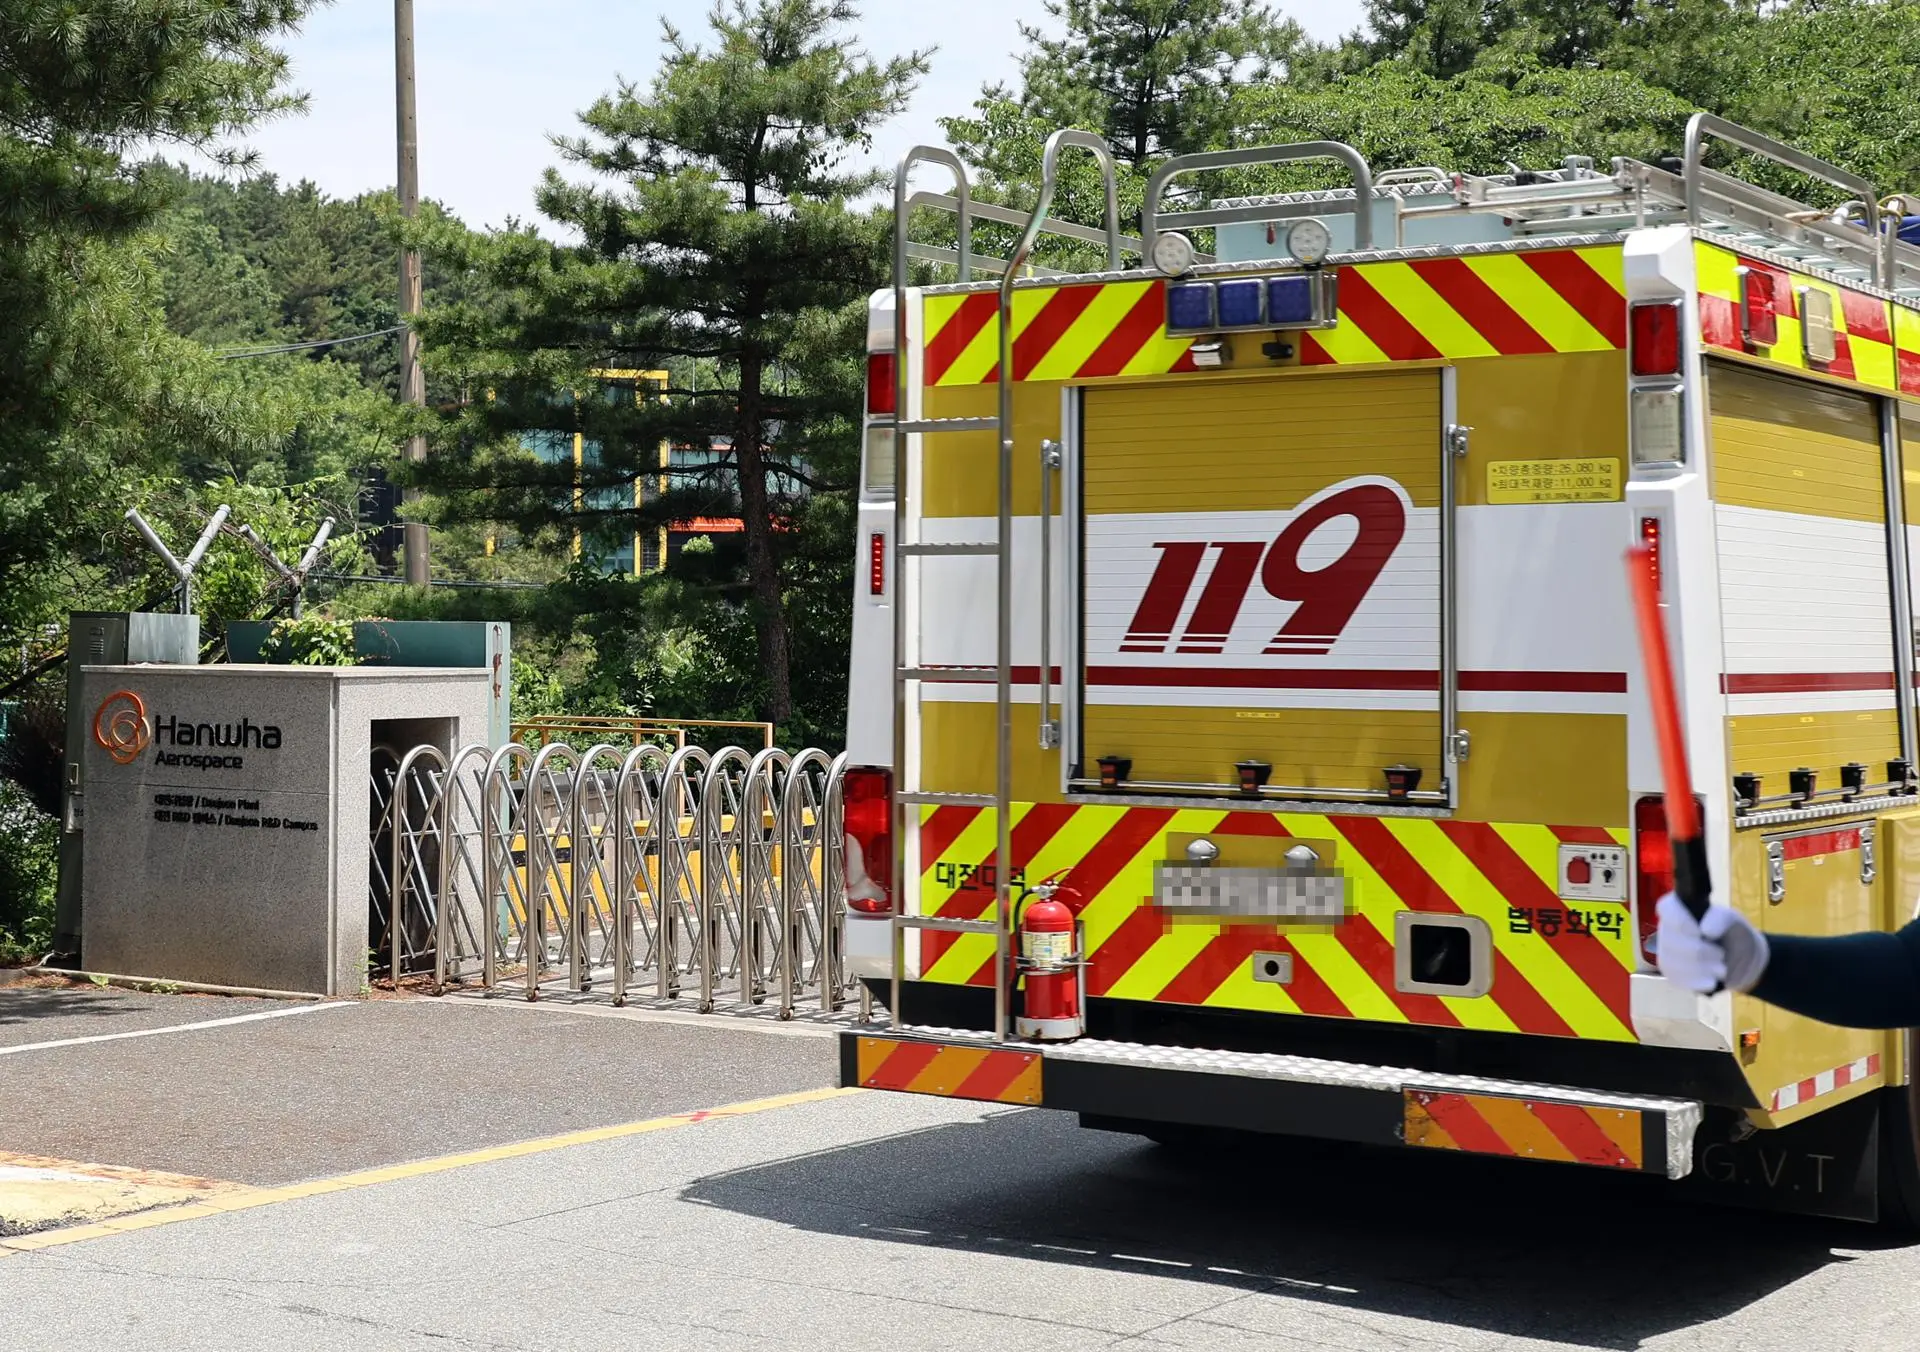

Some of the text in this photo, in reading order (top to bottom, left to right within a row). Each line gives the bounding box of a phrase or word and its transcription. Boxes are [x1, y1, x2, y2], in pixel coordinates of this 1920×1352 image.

[1118, 484, 1405, 655] 119
[154, 714, 282, 749] Hanwha
[155, 750, 243, 771] Aerospace
[1508, 906, 1625, 940] 법동화학
